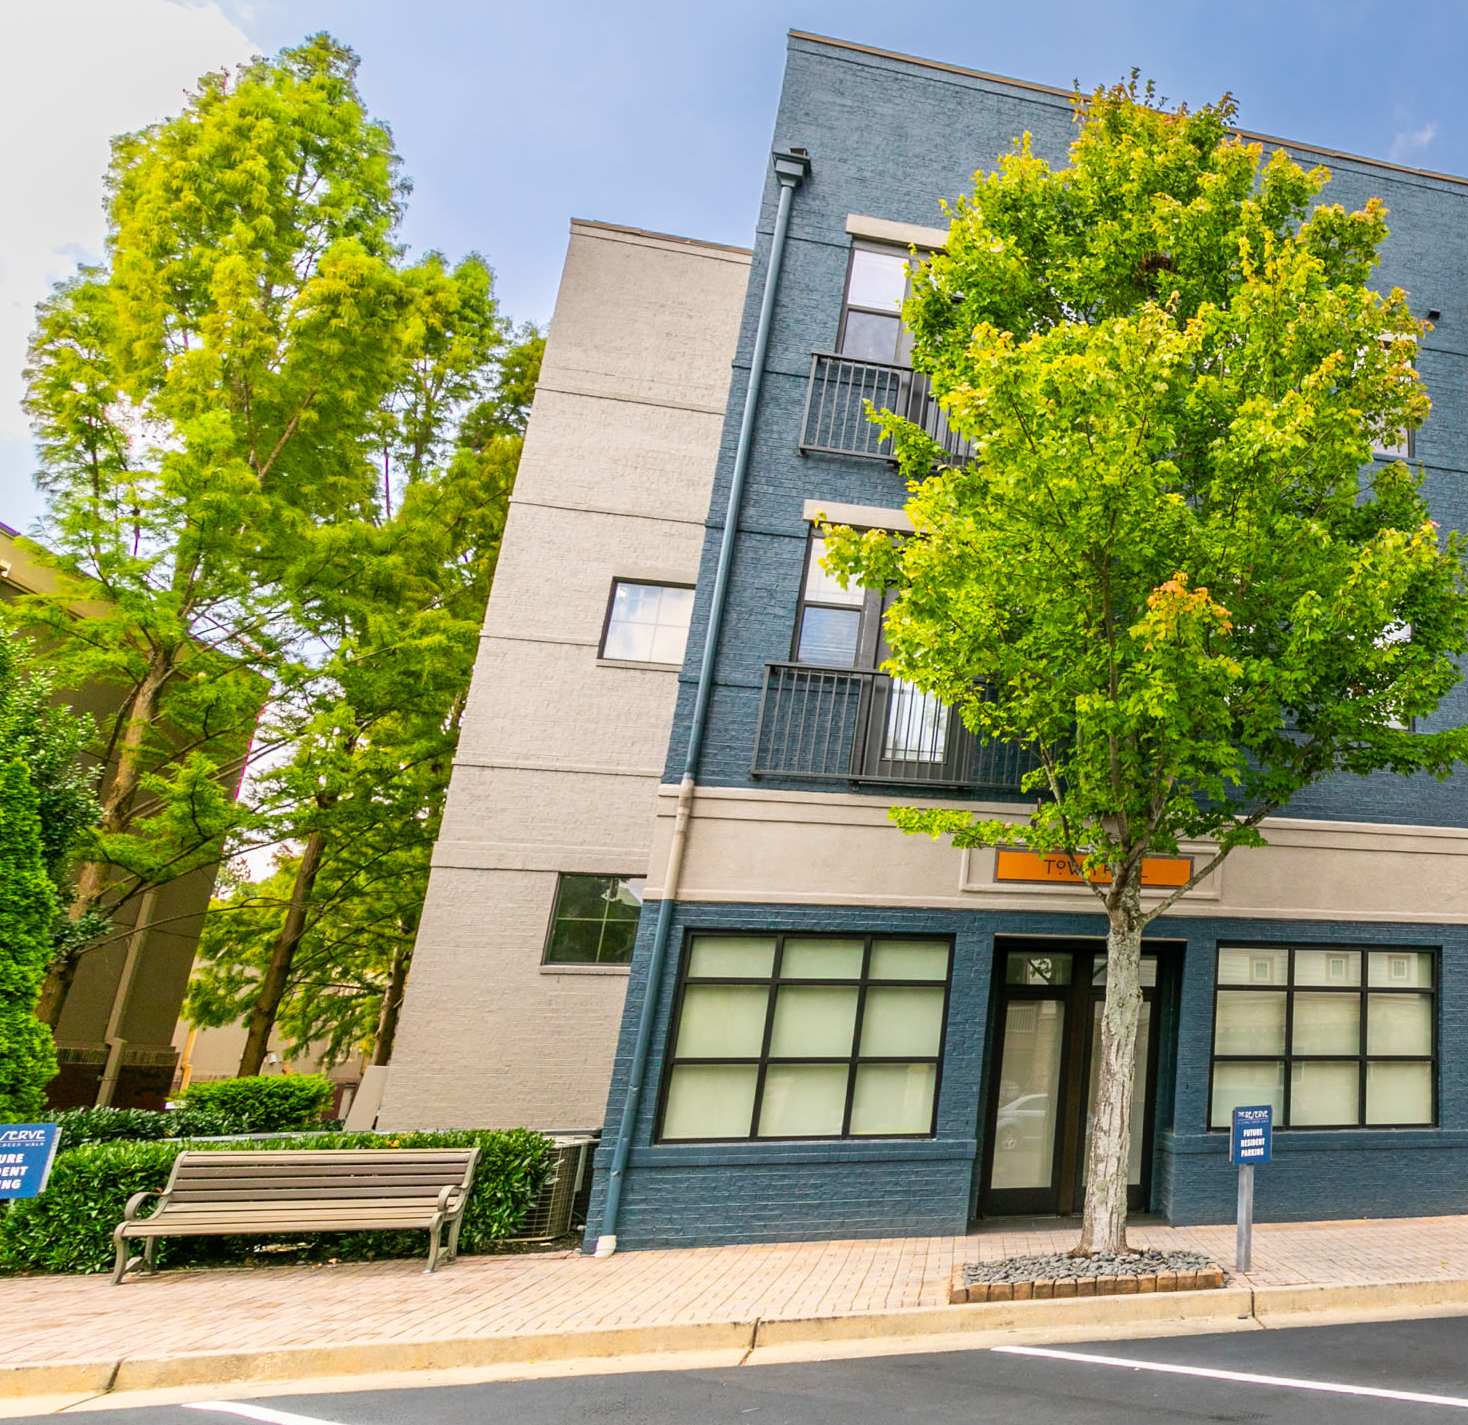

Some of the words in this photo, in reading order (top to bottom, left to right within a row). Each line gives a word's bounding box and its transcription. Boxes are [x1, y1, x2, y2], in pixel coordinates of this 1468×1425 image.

[1243, 1128, 1263, 1137] FUTURE
[1240, 1138, 1265, 1147] RESIDENT
[1240, 1148, 1264, 1157] PARKING
